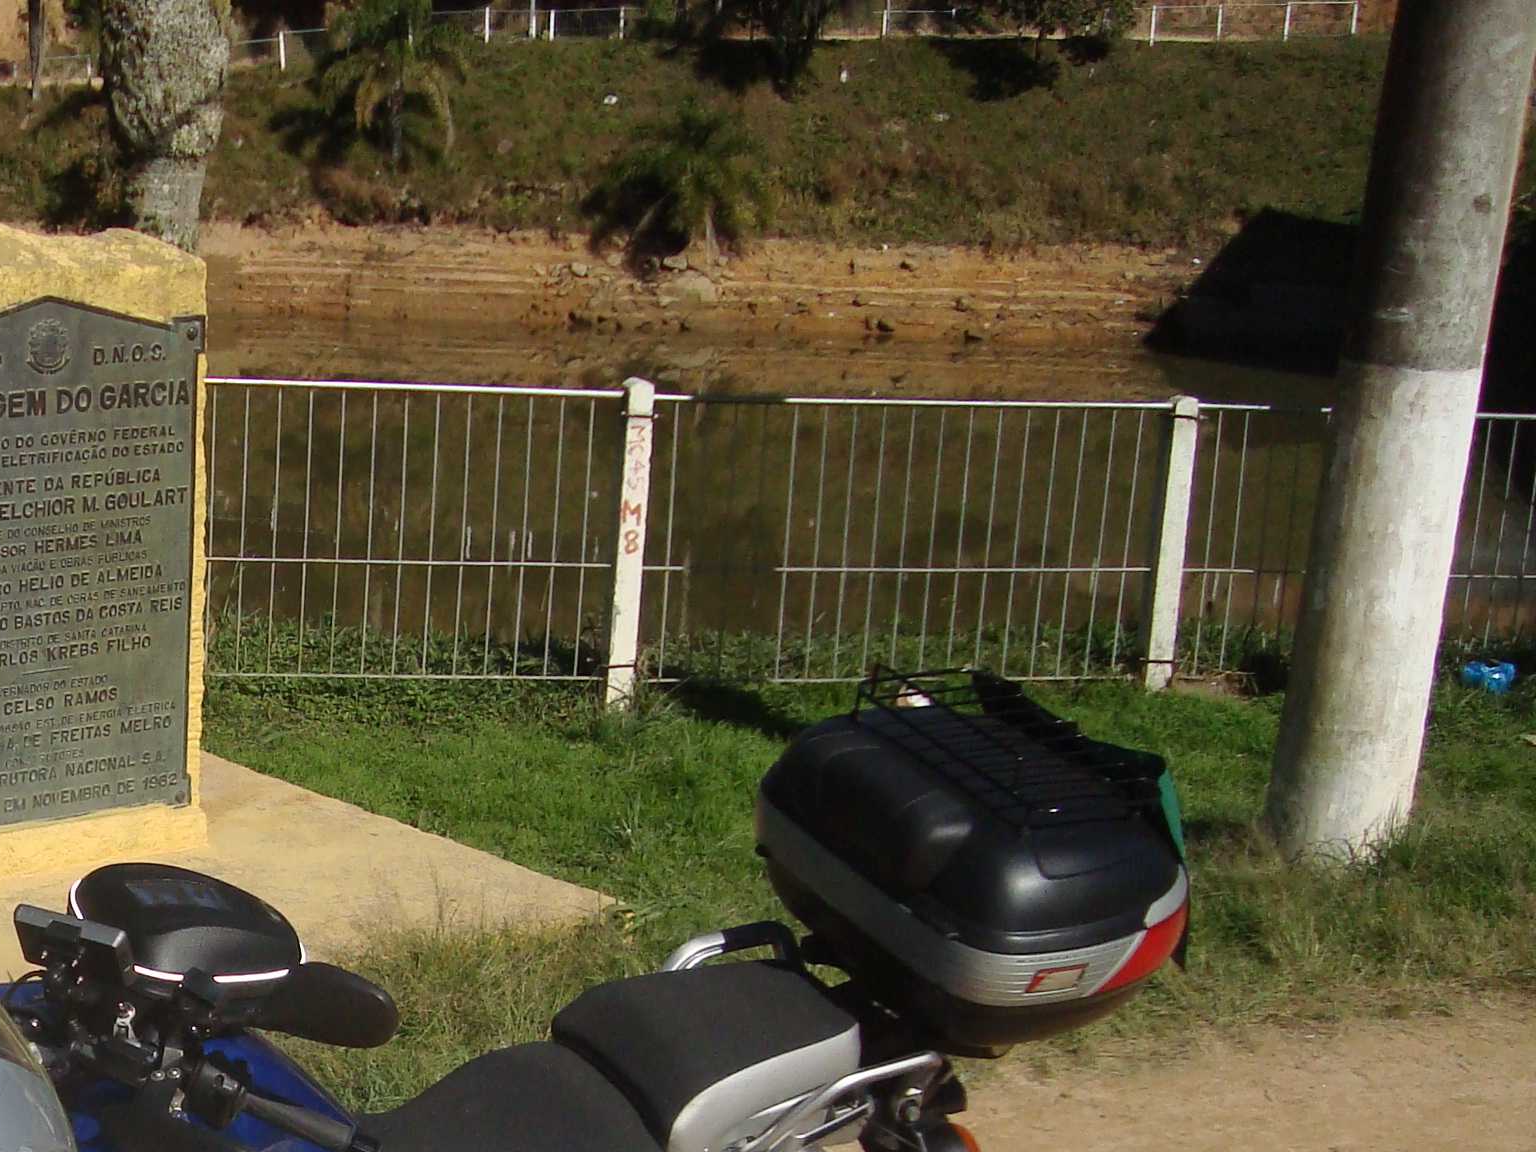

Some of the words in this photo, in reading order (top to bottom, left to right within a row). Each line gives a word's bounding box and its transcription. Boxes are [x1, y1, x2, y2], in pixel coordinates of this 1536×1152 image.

[56, 387, 92, 415] DO
[99, 380, 191, 410] GARCIA
[15, 434, 35, 449] DO
[40, 428, 107, 448] GOVÊRNO
[113, 425, 176, 441] FEDERAL
[1, 445, 107, 469] ELETRIFICAÇÃO
[112, 443, 130, 458] DO
[134, 441, 185, 456] ESTADO
[44, 477, 64, 492] DA
[71, 467, 162, 489] REPÚBLICA
[82, 495, 101, 513] M.
[104, 487, 189, 511] GOULART
[7, 528, 21, 540] DO
[24, 522, 79, 539] CONSELHO
[83, 521, 96, 531] DE
[101, 515, 152, 529] MINISTROS
[34, 535, 98, 554] HERMES
[105, 529, 143, 547] LIMA
[50, 559, 57, 570] E
[61, 556, 93, 569] OBRAS
[19, 574, 65, 593] HELIO
[70, 571, 90, 588] DE
[96, 564, 163, 585] ALMEIDA
[50, 595, 64, 606] DE
[67, 592, 99, 605] OBRAS
[104, 589, 117, 600] DE
[120, 581, 186, 598] SANEAMENTO
[14, 610, 71, 630] BASTOS
[75, 608, 94, 623] DA
[99, 601, 143, 620] COSTA
[149, 597, 184, 613] REIS
[47, 633, 61, 644] DE
[64, 628, 97, 642] SANTA
[101, 623, 147, 638] CATARINA
[47, 642, 100, 662] KREBS
[106, 635, 152, 653] FILHO
[53, 679, 67, 691] DO
[70, 673, 109, 689] ESTADO
[3, 695, 55, 717] CELSO
[63, 687, 118, 708] RAMOS
[61, 714, 74, 726] DE
[79, 709, 123, 723] ENERGIA
[23, 733, 42, 749] DE
[49, 723, 112, 744] FREITAS
[119, 714, 173, 736] MELRO
[64, 753, 136, 777] NACIONAL
[4, 796, 27, 814] EM
[31, 782, 111, 809] NOVEMBRO
[116, 777, 136, 796] DE
[142, 772, 179, 791] 1962
